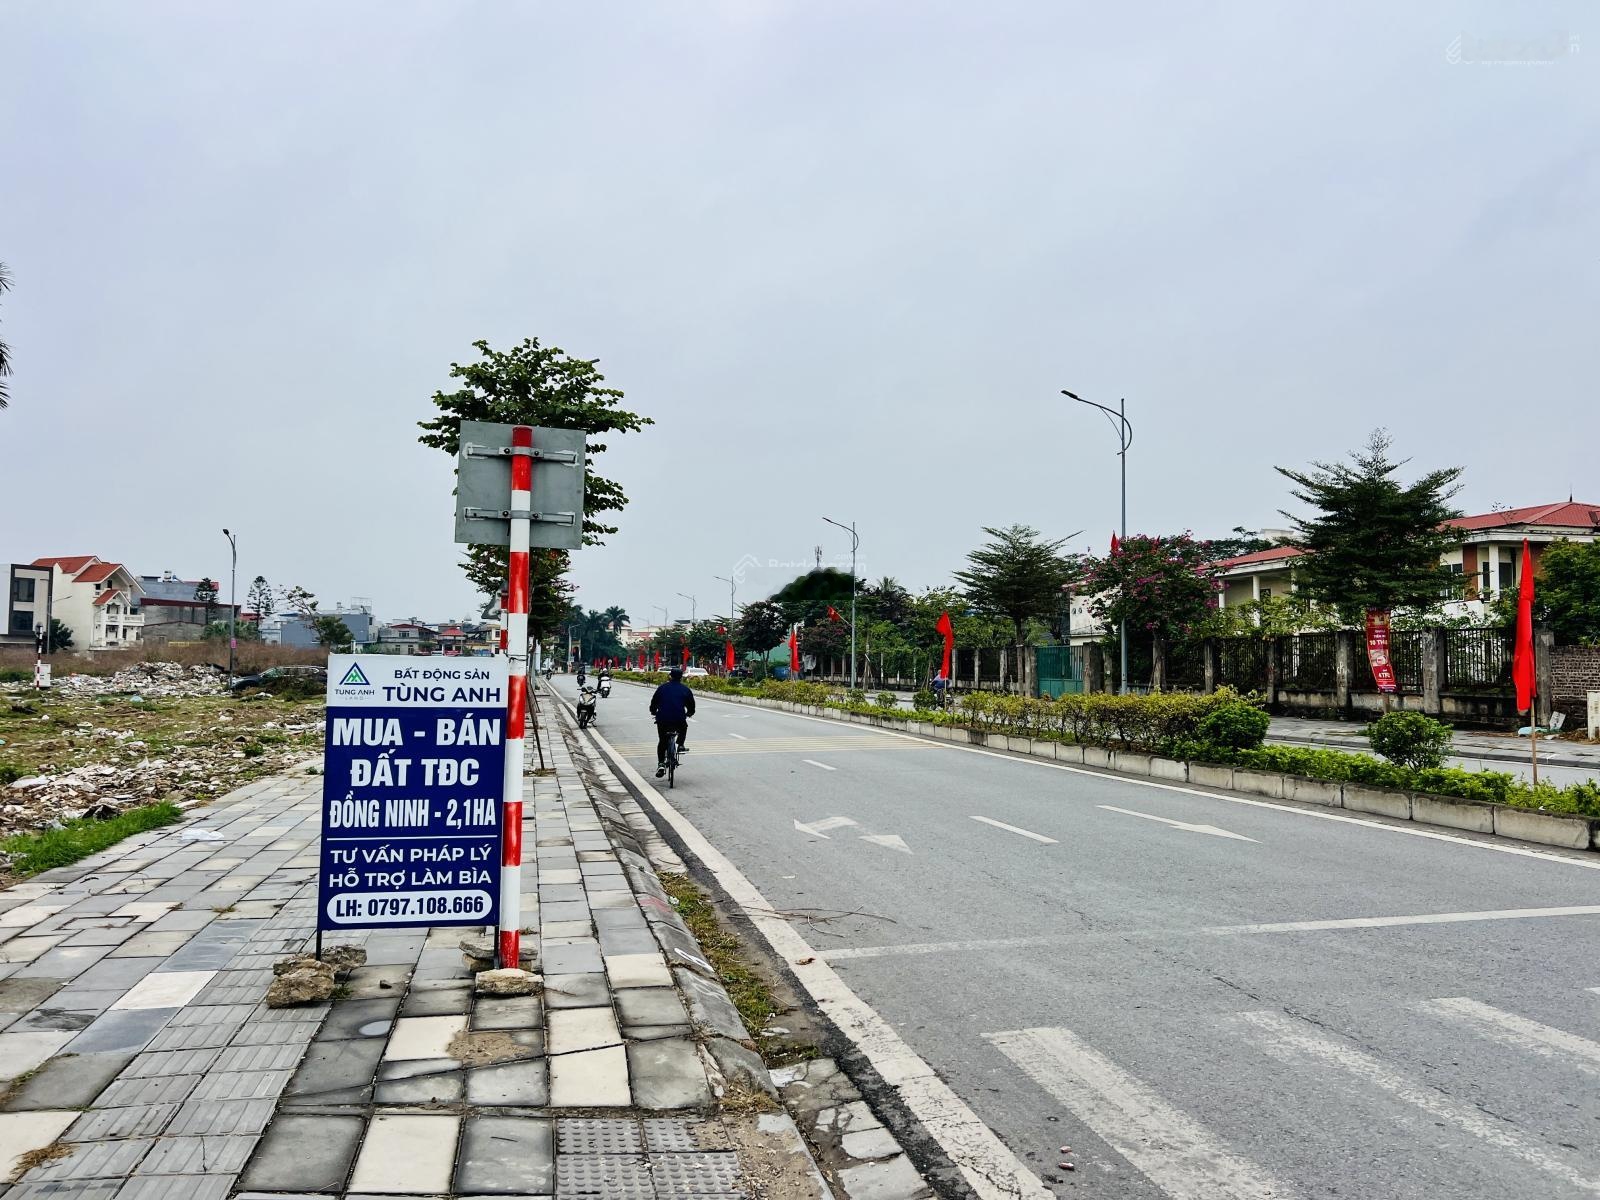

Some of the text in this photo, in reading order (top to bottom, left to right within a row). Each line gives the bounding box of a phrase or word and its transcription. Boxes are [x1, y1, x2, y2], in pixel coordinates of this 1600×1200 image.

[395, 667, 490, 681] BẤT ĐỘNG SẢN
[382, 683, 500, 702] TÙNG ANH
[332, 718, 403, 746] MUA
[436, 713, 500, 746] BÁN
[350, 749, 479, 786] ĐẤT TĐC
[330, 791, 379, 828] ĐỒNG
[385, 799, 429, 827] NINH
[446, 798, 496, 830] 2,1HA
[330, 843, 492, 863] TƯ VẤN PHÁP LÝ
[329, 867, 492, 889] HỖ TRỢ LÀM BÌA
[336, 896, 483, 917] LH: 0797.108.666
